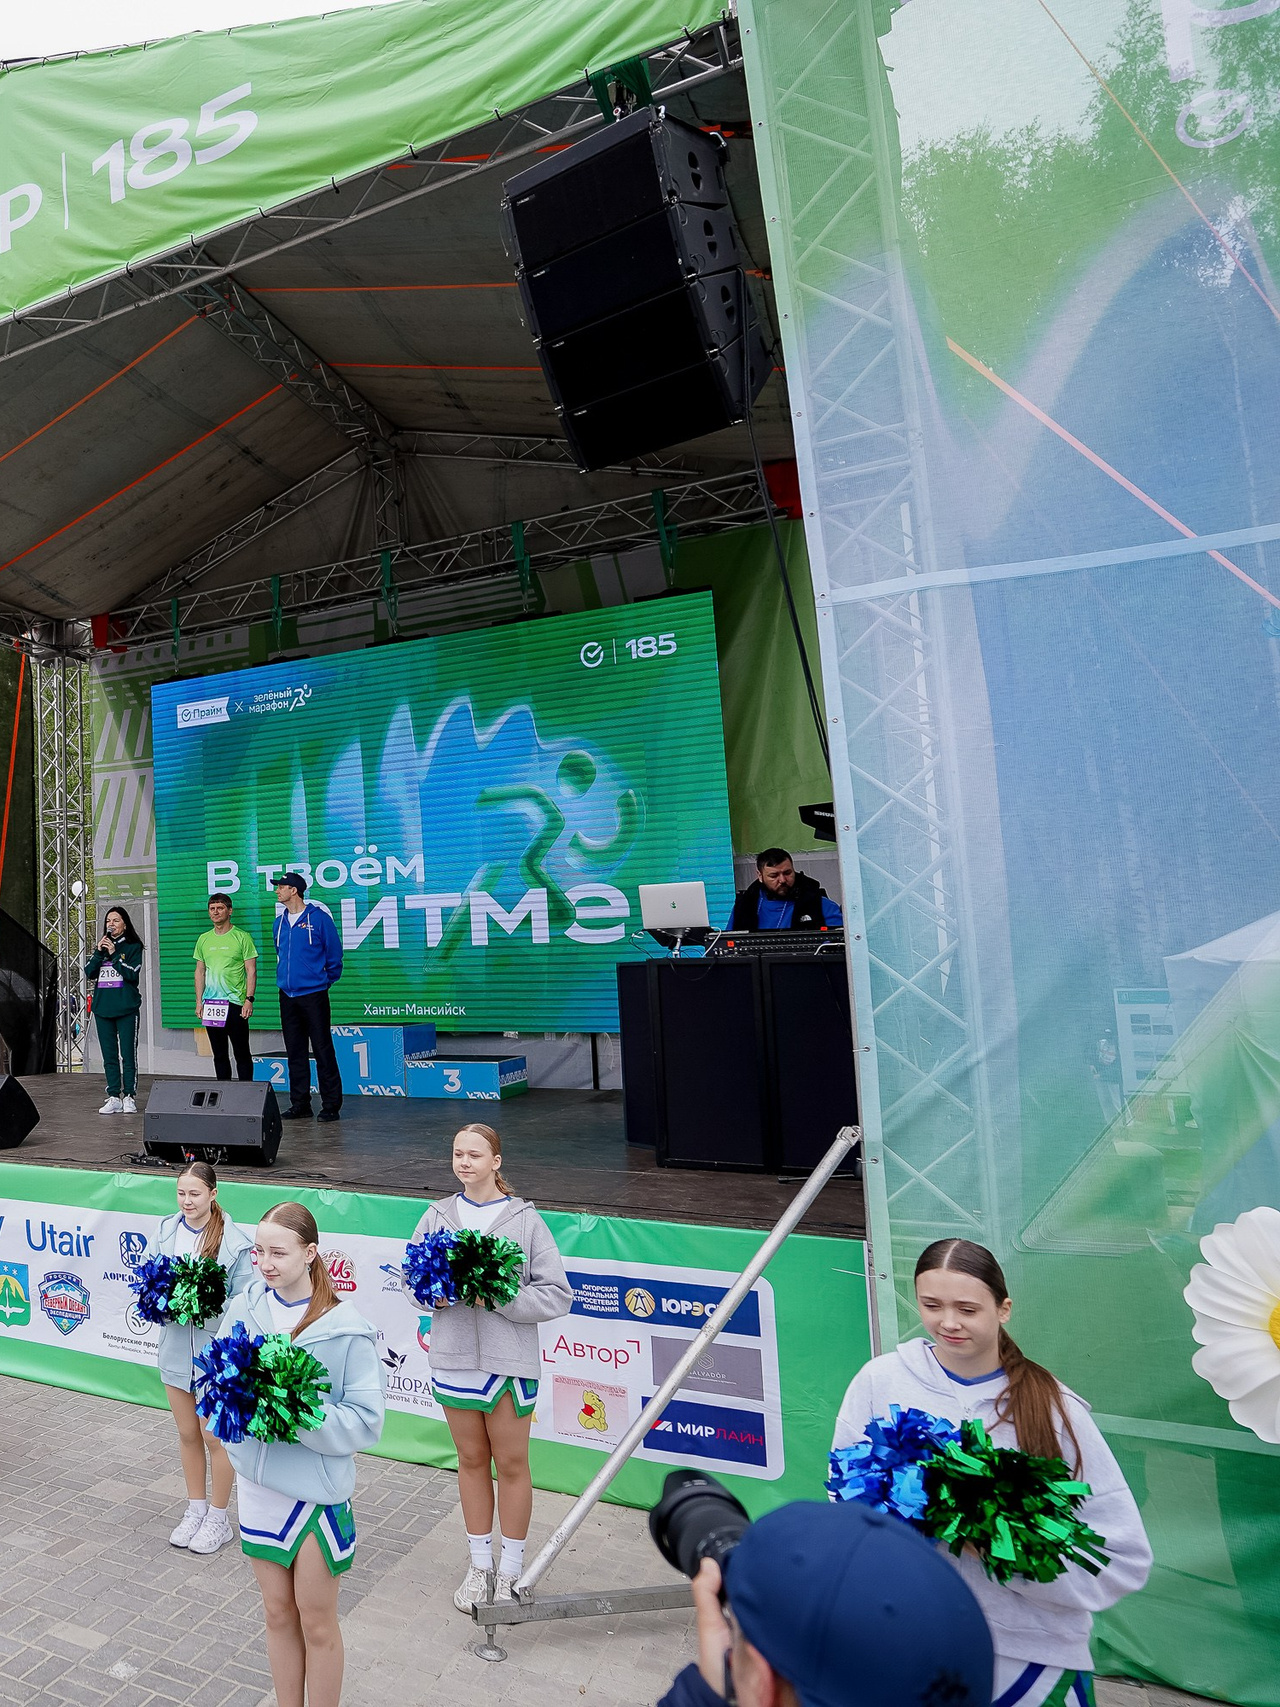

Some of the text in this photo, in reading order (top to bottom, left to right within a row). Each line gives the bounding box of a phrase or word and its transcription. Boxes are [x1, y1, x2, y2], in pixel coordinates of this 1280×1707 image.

[91, 81, 259, 205] 185
[625, 632, 678, 660] 185
[253, 687, 293, 703] зелёный
[193, 705, 223, 719] Прайм
[248, 700, 289, 714] марафон
[206, 860, 241, 896] В
[207, 1008, 226, 1017] 2185
[363, 1003, 466, 1017] Ханты-Мансийск
[352, 1041, 371, 1079] 1
[269, 1062, 287, 1084] 2
[443, 1069, 462, 1094] 3
[25, 1218, 95, 1258] Utair
[572, 1289, 619, 1300] ЕГИОНАЛЬНАЯ
[582, 1283, 619, 1293] ЮГОРСКАЯ
[573, 1295, 620, 1306] КТРОСЕТЕВАЯ
[582, 1303, 620, 1313] КОМПАНИЯ
[661, 1297, 731, 1321] ЮРЭС
[102, 1332, 143, 1346] Белорусские
[553, 1334, 630, 1370] Автор
[420, 1400, 433, 1408] спа
